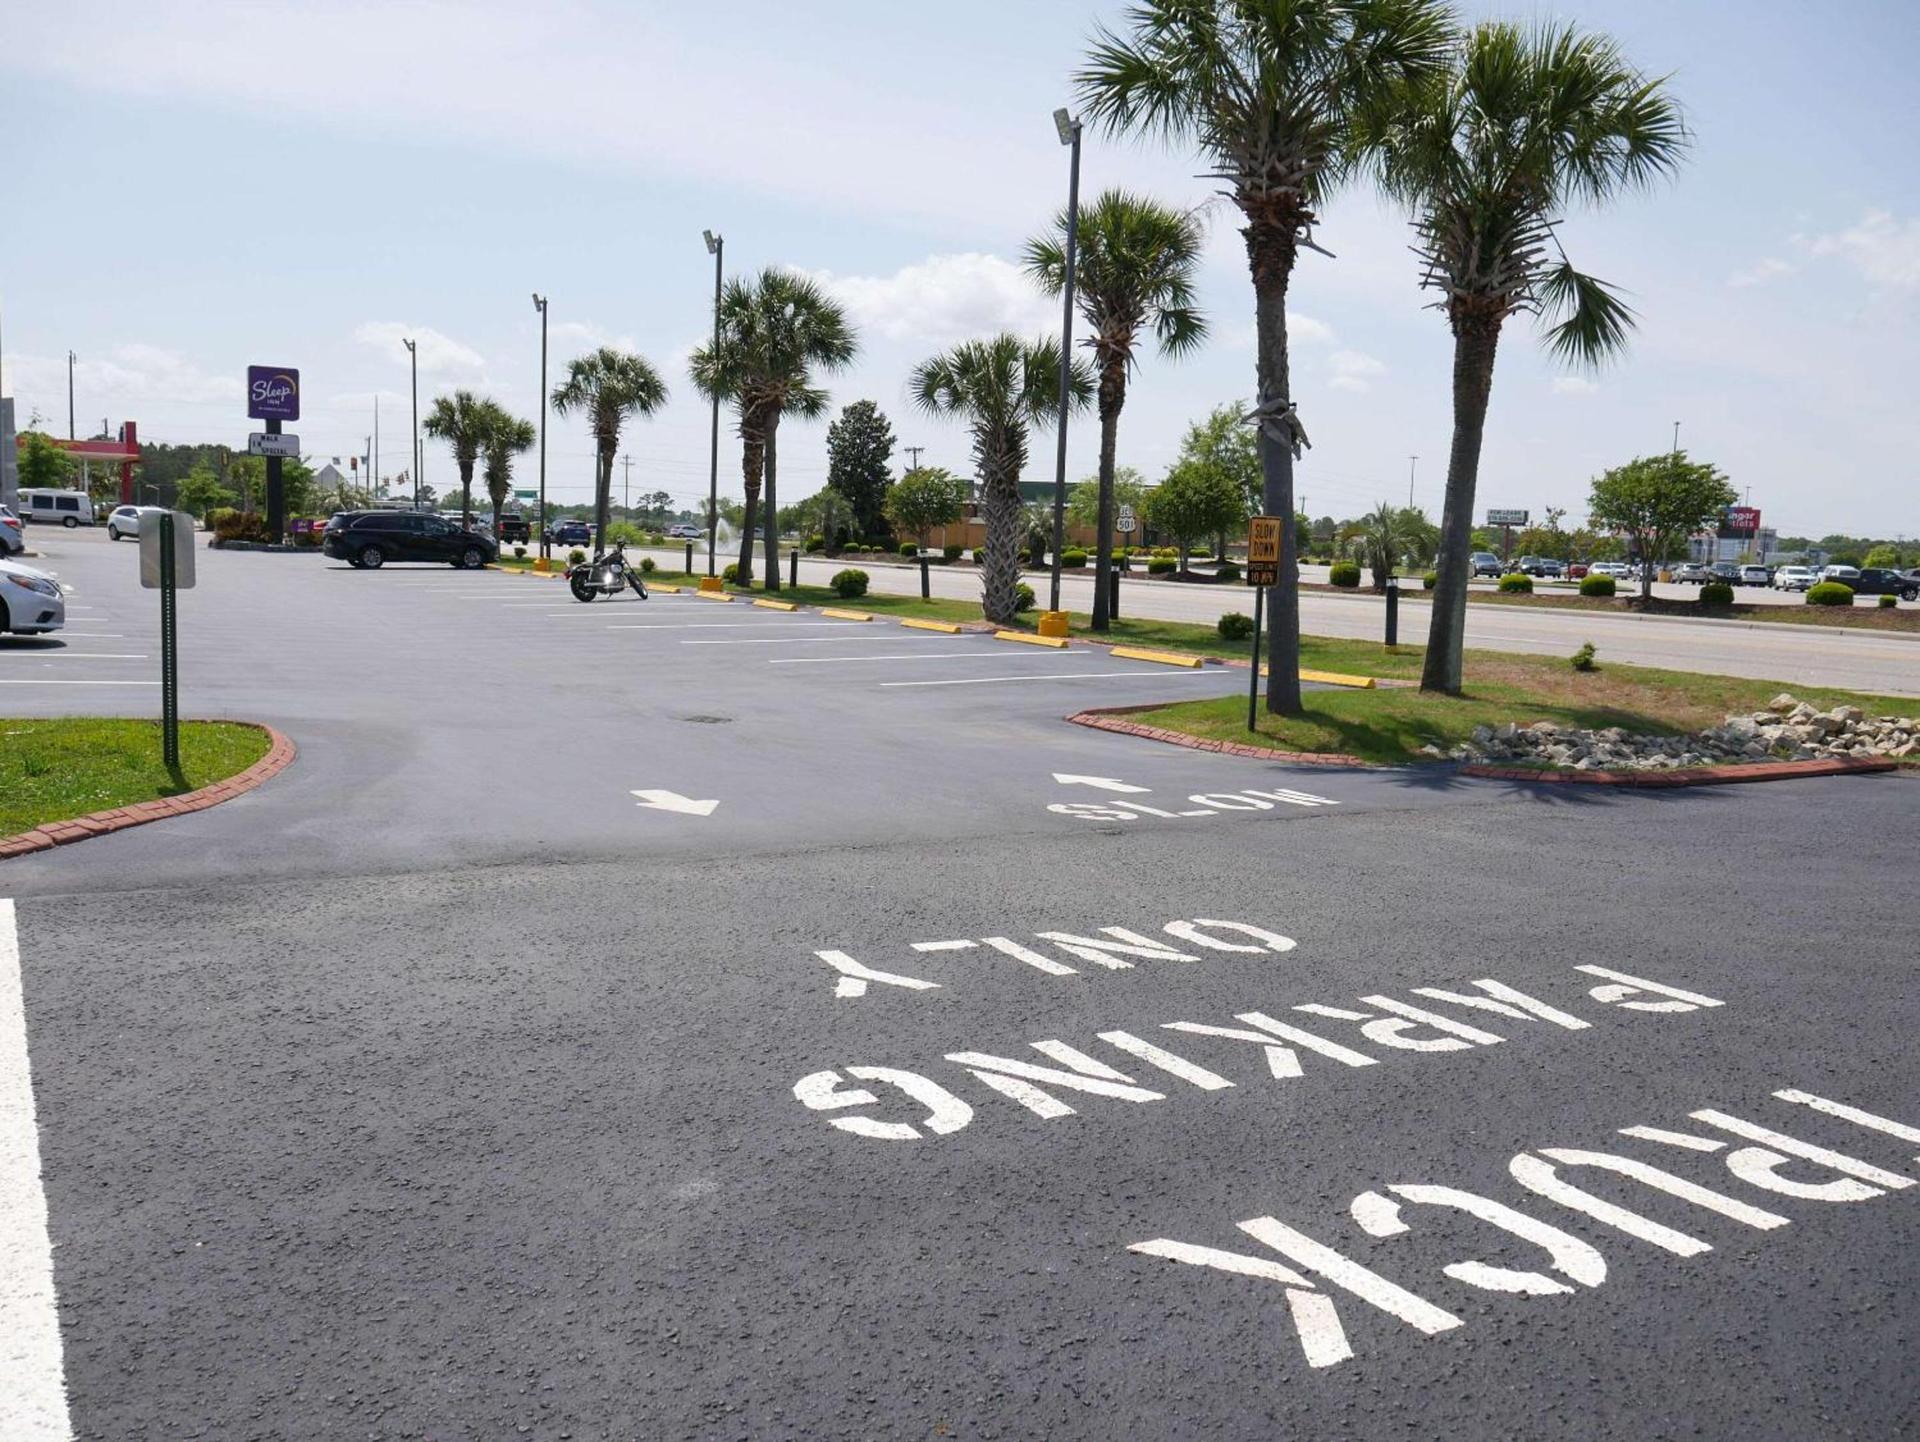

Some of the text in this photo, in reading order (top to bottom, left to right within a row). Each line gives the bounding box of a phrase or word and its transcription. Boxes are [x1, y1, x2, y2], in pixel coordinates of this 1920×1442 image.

[252, 380, 291, 402] Sleep
[261, 447, 288, 455] SPECIAL
[1728, 512, 1755, 520] nger
[1119, 519, 1134, 530] 501
[1255, 523, 1276, 538] SLOW
[1732, 520, 1754, 528] tlets
[1253, 541, 1275, 556] DOWN
[1047, 789, 1341, 820] SLOW
[813, 918, 1298, 998] ONLY
[793, 965, 1726, 1136] PARKING
